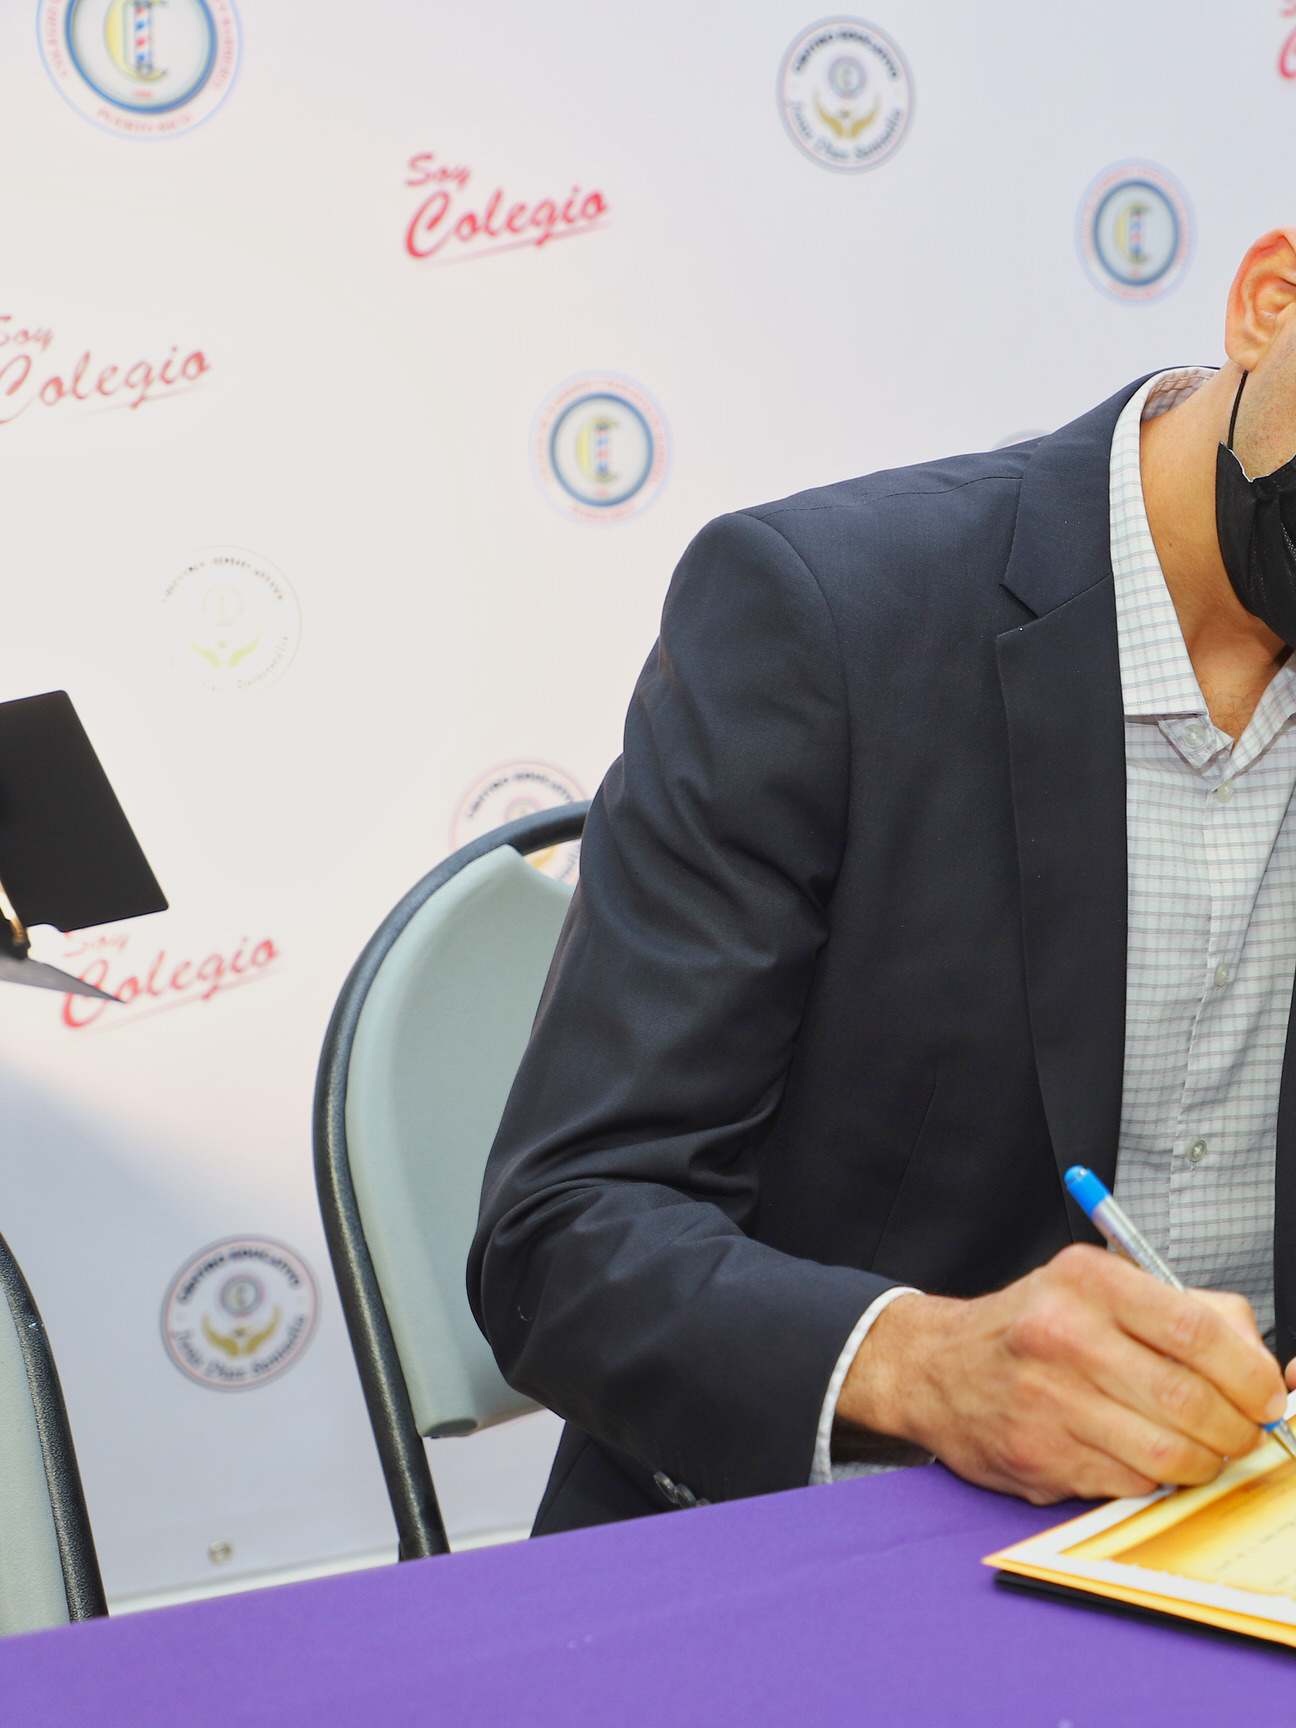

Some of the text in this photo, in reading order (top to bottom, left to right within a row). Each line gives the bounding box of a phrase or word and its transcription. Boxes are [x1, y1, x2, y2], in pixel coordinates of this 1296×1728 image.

[405, 152, 471, 190] Soy
[404, 186, 608, 259] Colegio
[0, 345, 211, 424] Colegio
[61, 935, 280, 1029] Colegio
